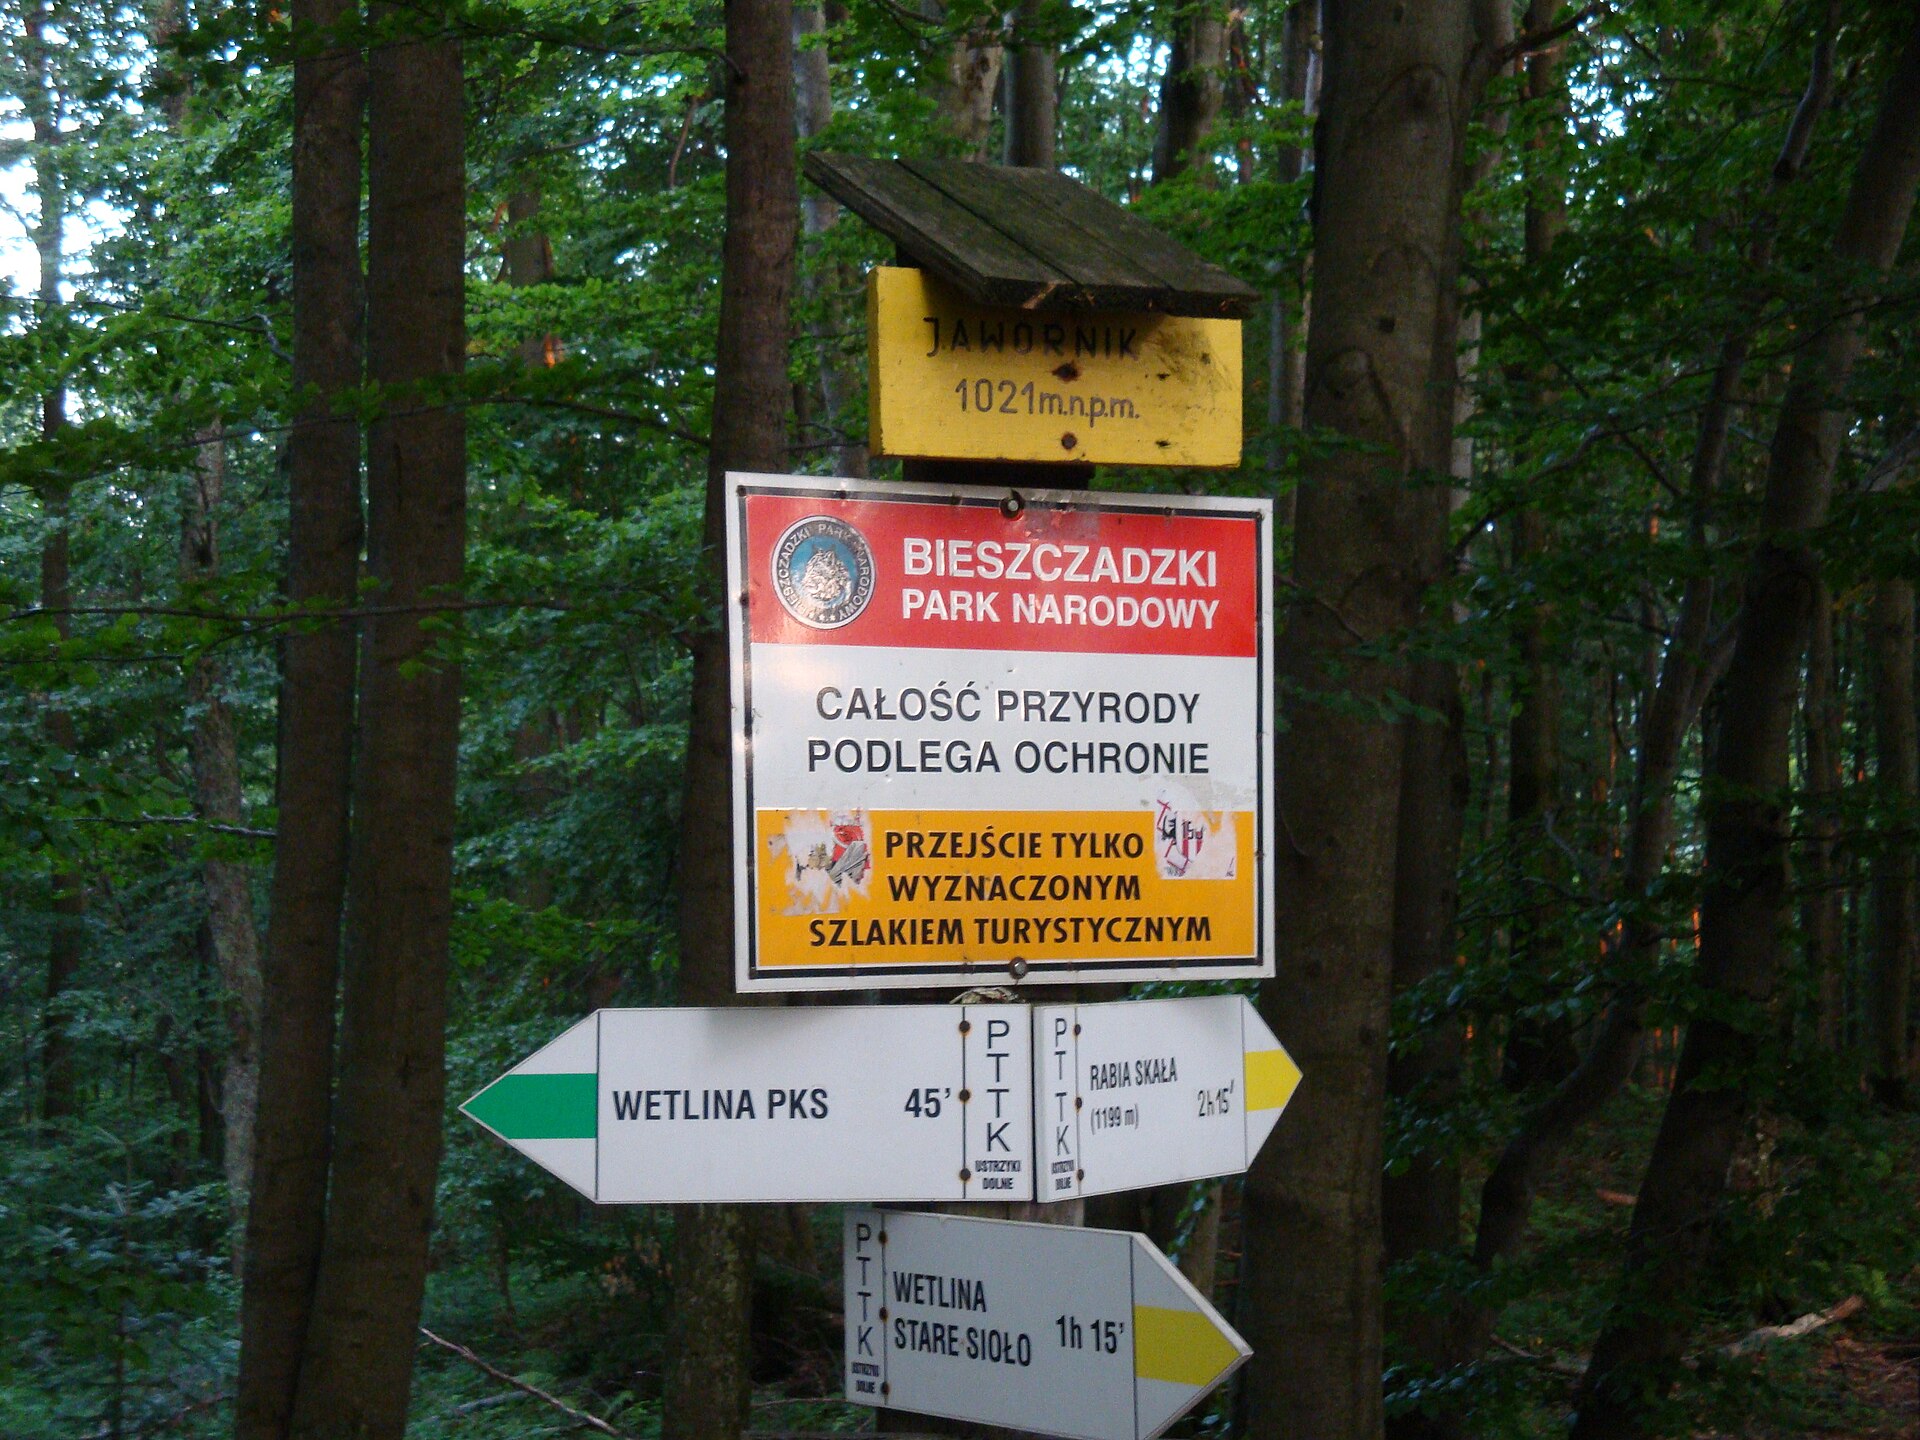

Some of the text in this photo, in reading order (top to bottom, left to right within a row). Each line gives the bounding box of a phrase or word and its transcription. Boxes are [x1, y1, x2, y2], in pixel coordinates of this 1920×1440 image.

[922, 317, 1139, 361] JAWORNIK
[902, 537, 1217, 588] BIESZCZADZKI
[902, 588, 1219, 630] PARK NARODOWY
[816, 680, 1201, 724] CAŁOŚĆ PRZYRODY
[808, 739, 1209, 775] PODLEGA OCHRONIE
[886, 825, 1144, 859] PRZEJŚCIE TYLKO
[887, 874, 1141, 902] WYZNACZONYM
[809, 916, 1211, 947] SZLAKIEM TURYSTYCZNYM
[1090, 1056, 1178, 1092] RABIA SKAŁA
[612, 1087, 952, 1121] WETLINA PKS 45'
[1198, 1090, 1214, 1118] 2h
[892, 1270, 987, 1313] WETLINA
[894, 1317, 1032, 1367] STARE SIOŁO
[1055, 1314, 1125, 1355] 1h 15'
